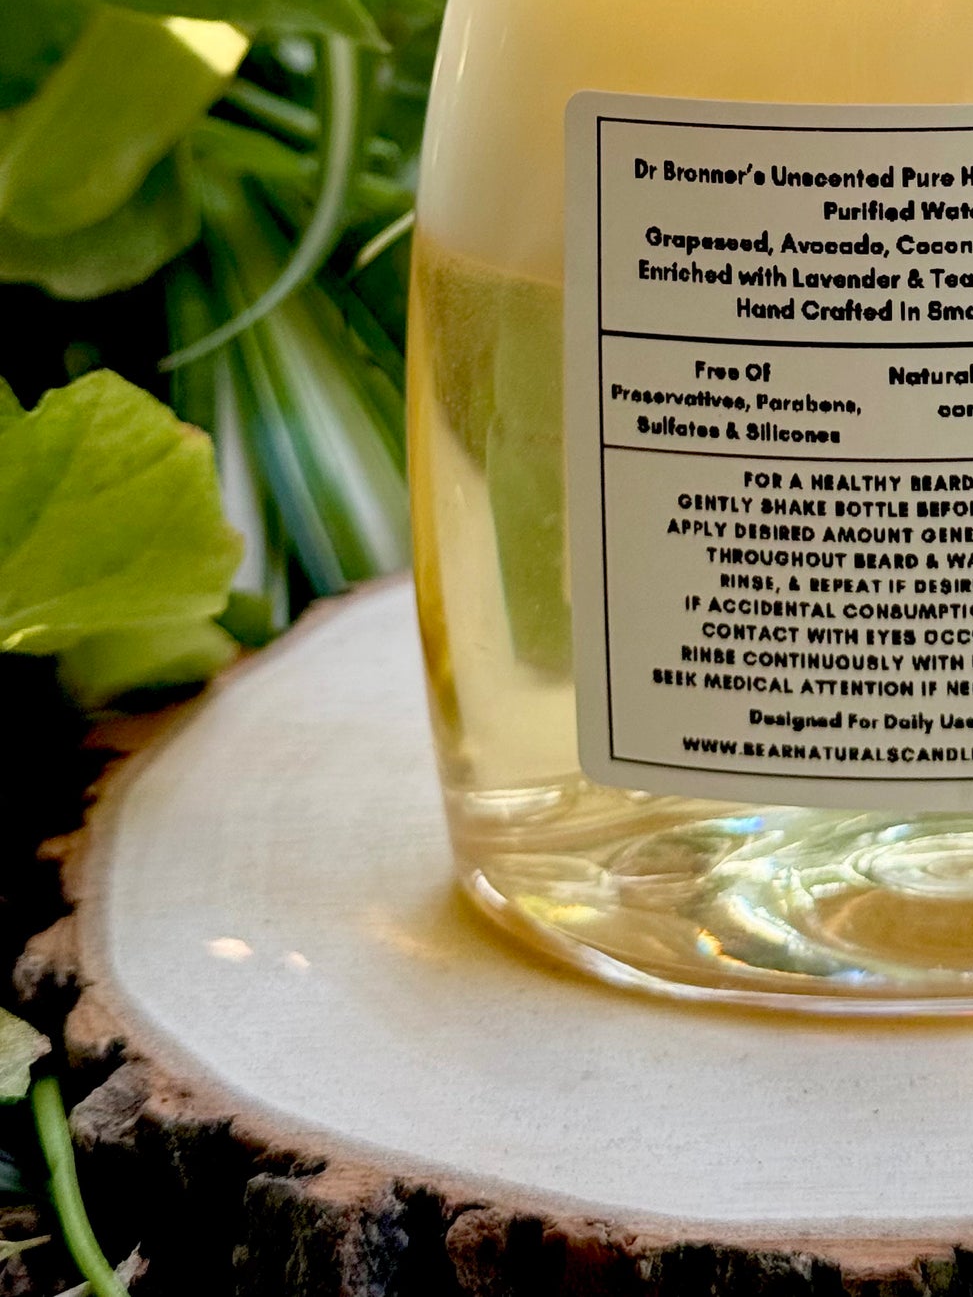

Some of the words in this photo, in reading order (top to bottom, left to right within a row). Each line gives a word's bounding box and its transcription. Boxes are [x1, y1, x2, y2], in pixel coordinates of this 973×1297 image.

[634, 157, 658, 180] Dr
[770, 164, 895, 189] Unscented
[901, 166, 956, 188] Pure
[823, 199, 916, 223] Purified
[638, 258, 733, 286] Enriched
[737, 264, 788, 288] with
[792, 266, 902, 290] Lavender
[907, 268, 926, 290] &
[736, 296, 795, 320] Hand
[800, 298, 893, 322] Crafted
[899, 300, 921, 322] In
[694, 359, 740, 382] Free
[744, 361, 772, 383] Of
[636, 415, 721, 439] Sulfates
[725, 421, 741, 441] &
[745, 421, 841, 444] Silicones
[743, 470, 783, 490] FOR
[788, 472, 804, 491] A
[810, 473, 902, 493] HEALTHY
[677, 493, 753, 514] GENTLY
[760, 497, 827, 517] SHAKE
[834, 500, 909, 519] BOTTLE
[666, 517, 728, 538] APPLY
[734, 521, 816, 542] DESIRED
[821, 526, 915, 544] AMOUNT
[705, 546, 848, 569] THROUGHOUT
[853, 552, 919, 570] BEARD
[925, 552, 940, 570] &
[788, 575, 801, 592] &
[809, 577, 883, 594] REPEAT
[888, 578, 907, 595] IF
[684, 595, 702, 612] IF
[707, 596, 837, 619] ACCIDENTAL
[701, 621, 800, 644] CONTACT
[807, 627, 859, 646] WITH
[865, 628, 917, 646] EYES
[680, 644, 736, 666] RINSE
[742, 650, 904, 672] CONTINUOUSLY
[911, 654, 965, 672] WITH
[652, 667, 698, 688] SEEK
[703, 672, 794, 695] MEDICAL
[799, 678, 914, 698] ATTENTION
[920, 680, 938, 697] IF
[748, 708, 843, 733] Designed
[847, 712, 879, 730] For
[883, 711, 934, 735] Daily
